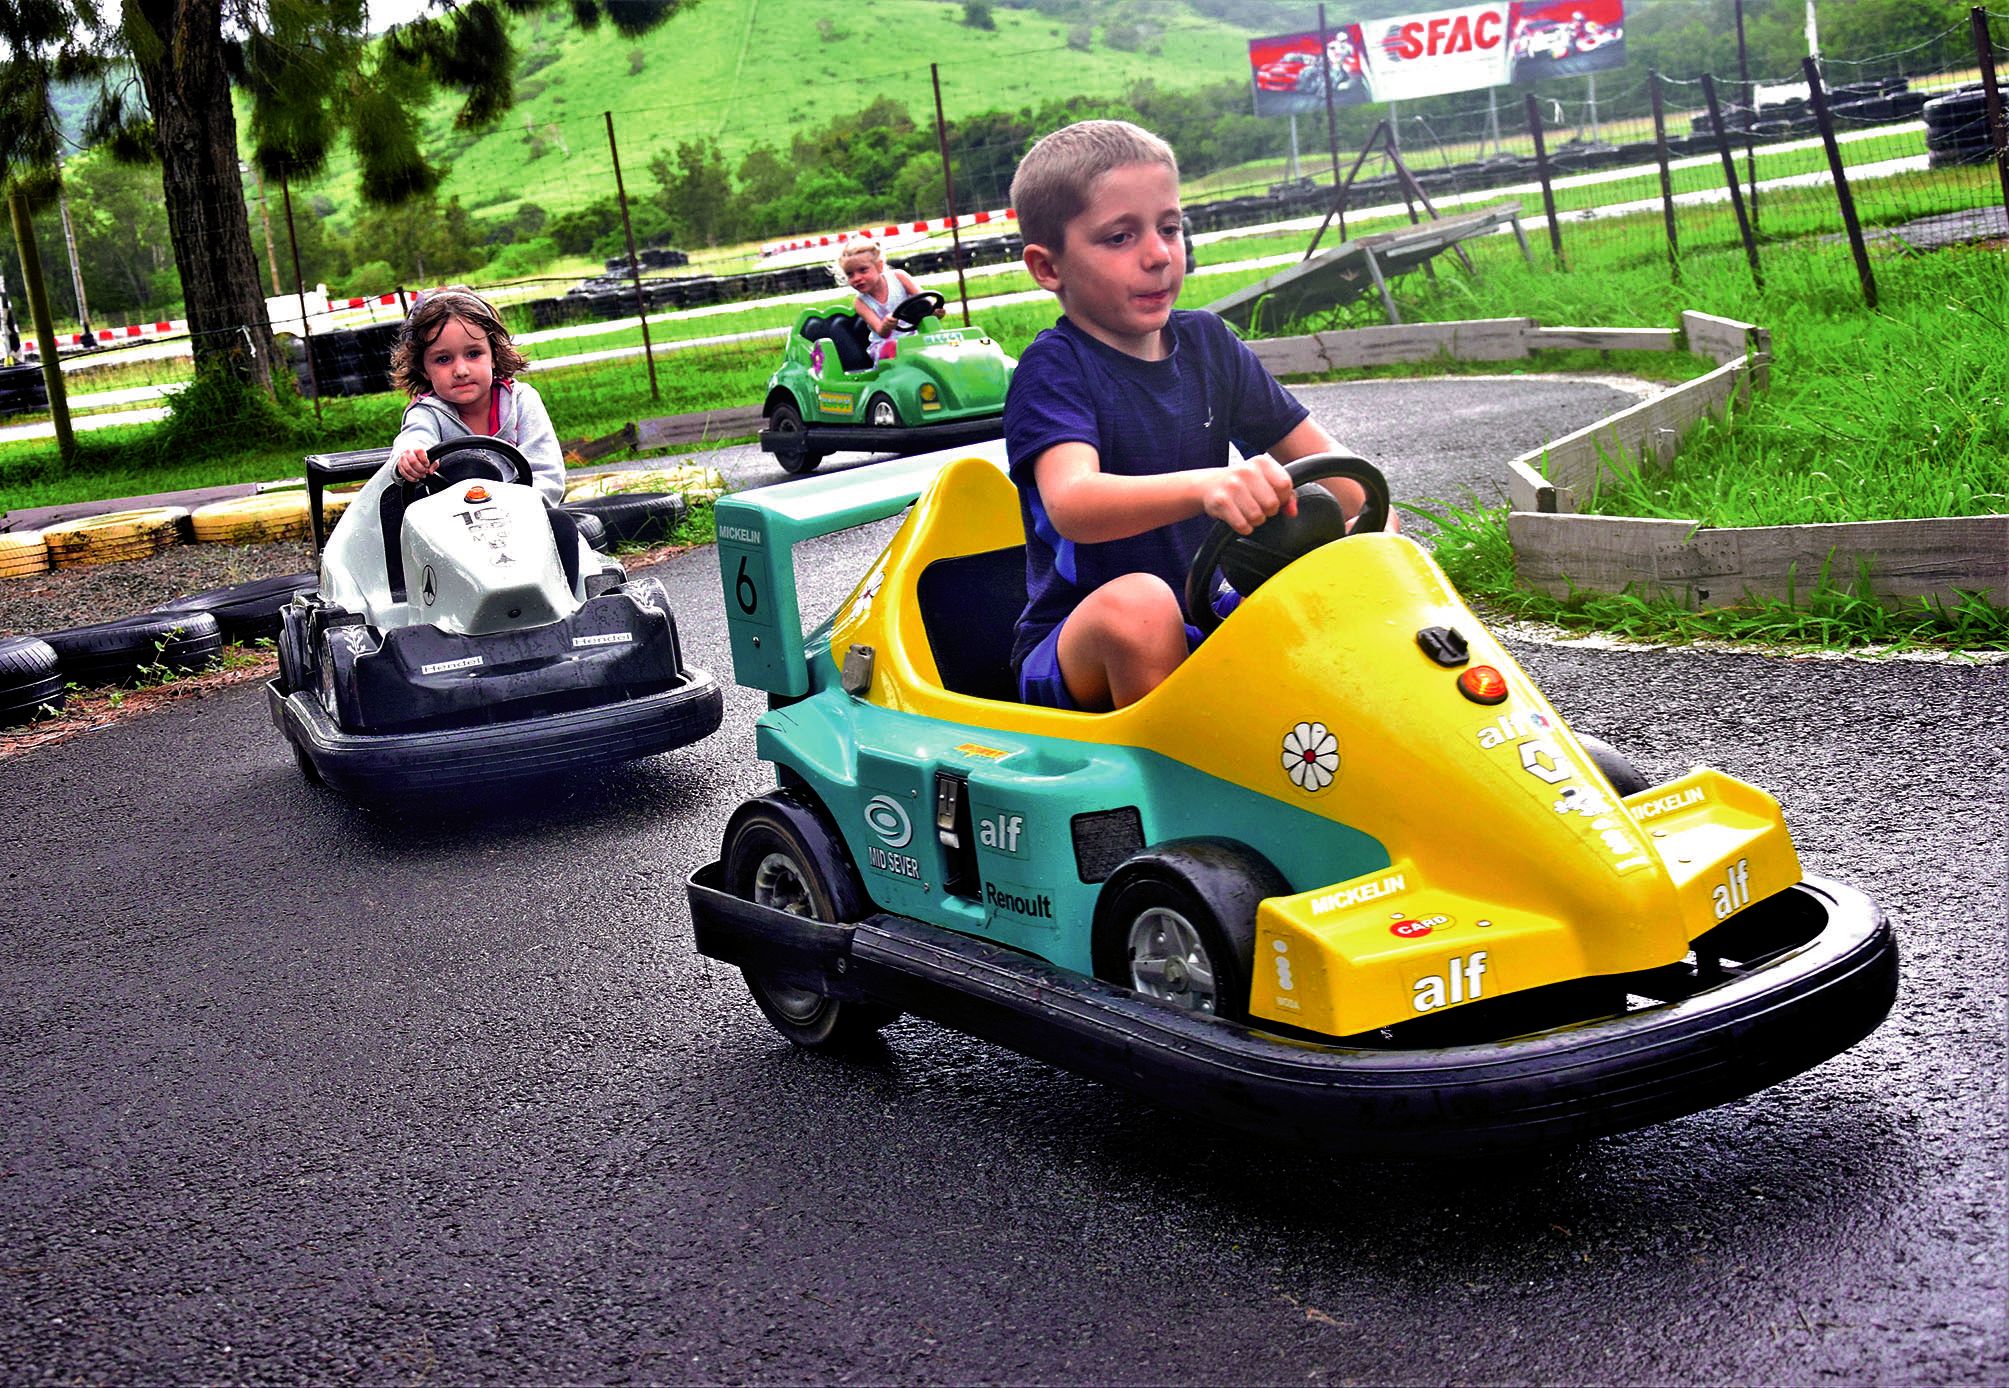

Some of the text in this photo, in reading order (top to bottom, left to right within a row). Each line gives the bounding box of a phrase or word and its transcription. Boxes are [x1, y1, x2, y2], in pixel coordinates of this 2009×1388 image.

[1399, 11, 1501, 59] SFAC
[719, 525, 760, 543] MICKELIN
[736, 555, 757, 615] 6
[575, 634, 631, 646] Hendel
[424, 658, 482, 672] Hendel
[980, 814, 1023, 852] alf
[868, 846, 921, 879] MID SEVER
[986, 882, 1052, 918] Renoult
[1311, 874, 1405, 916] MICKELIN
[1712, 858, 1750, 920] alf
[1397, 914, 1449, 936] CARD
[1412, 951, 1488, 1012] alf
